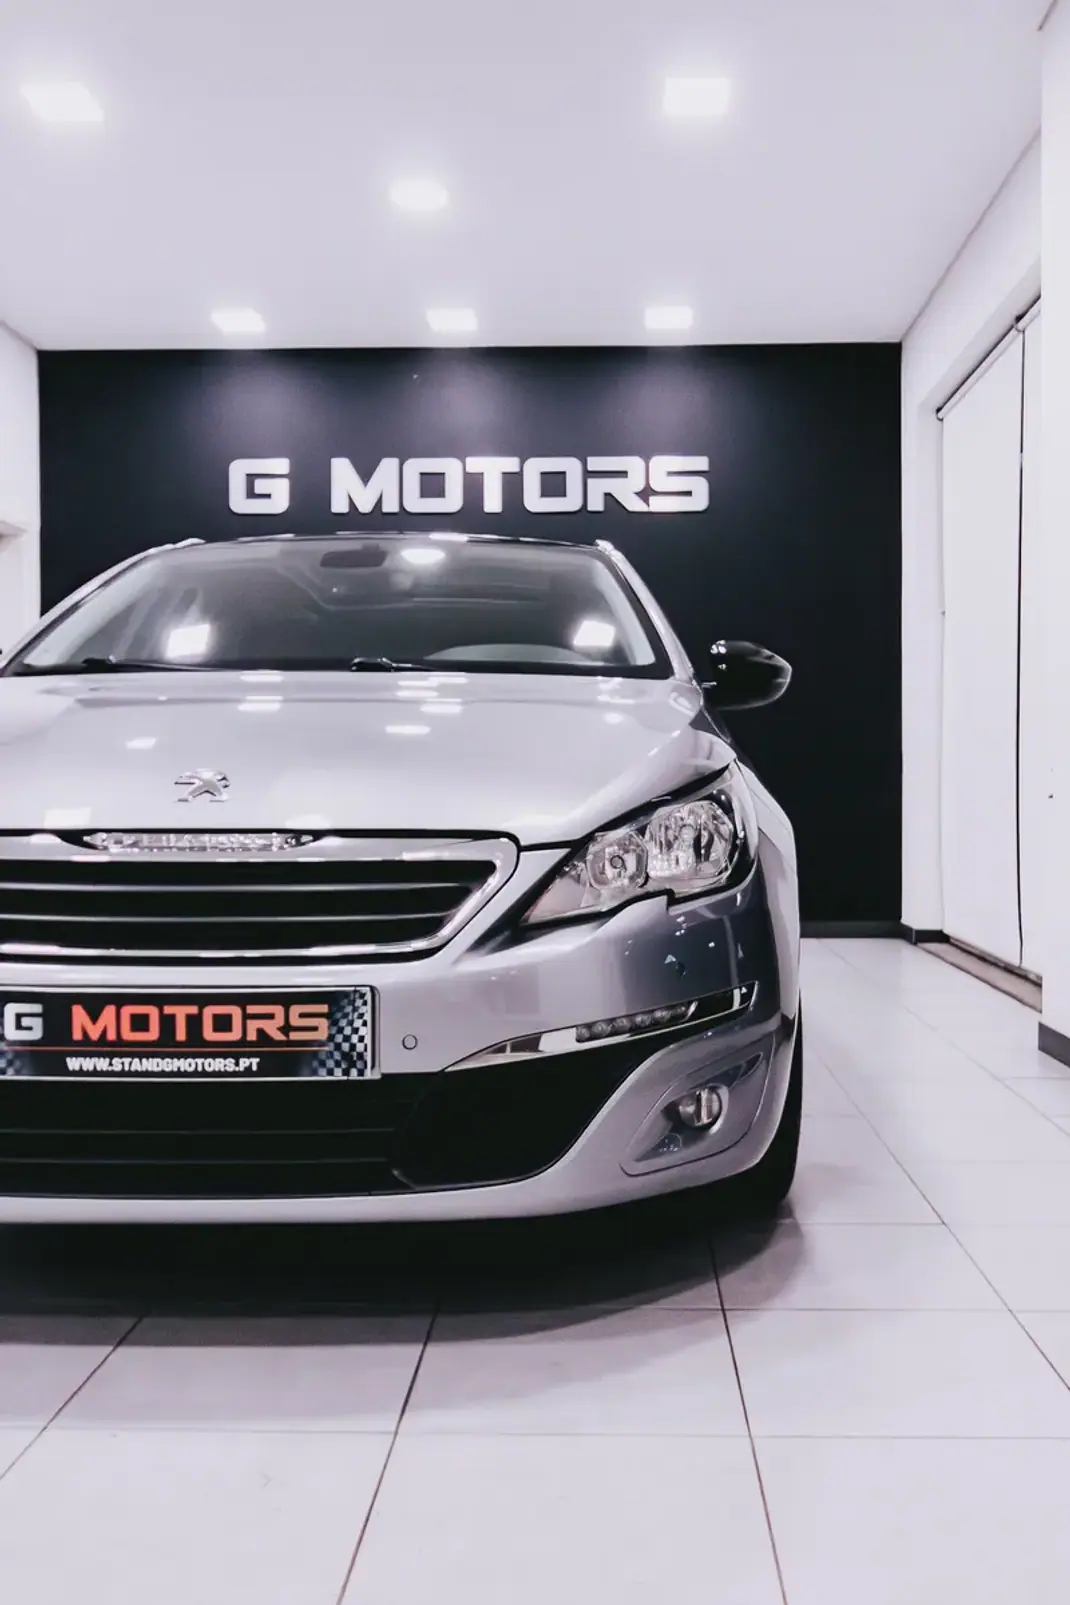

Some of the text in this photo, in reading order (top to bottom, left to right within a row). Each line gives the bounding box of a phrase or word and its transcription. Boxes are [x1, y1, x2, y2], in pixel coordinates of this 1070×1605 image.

[228, 456, 710, 515] G MOTORS
[3, 1002, 329, 1042] G MOTORS
[66, 1057, 260, 1073] WWW.STANDGMOTORS.PT
